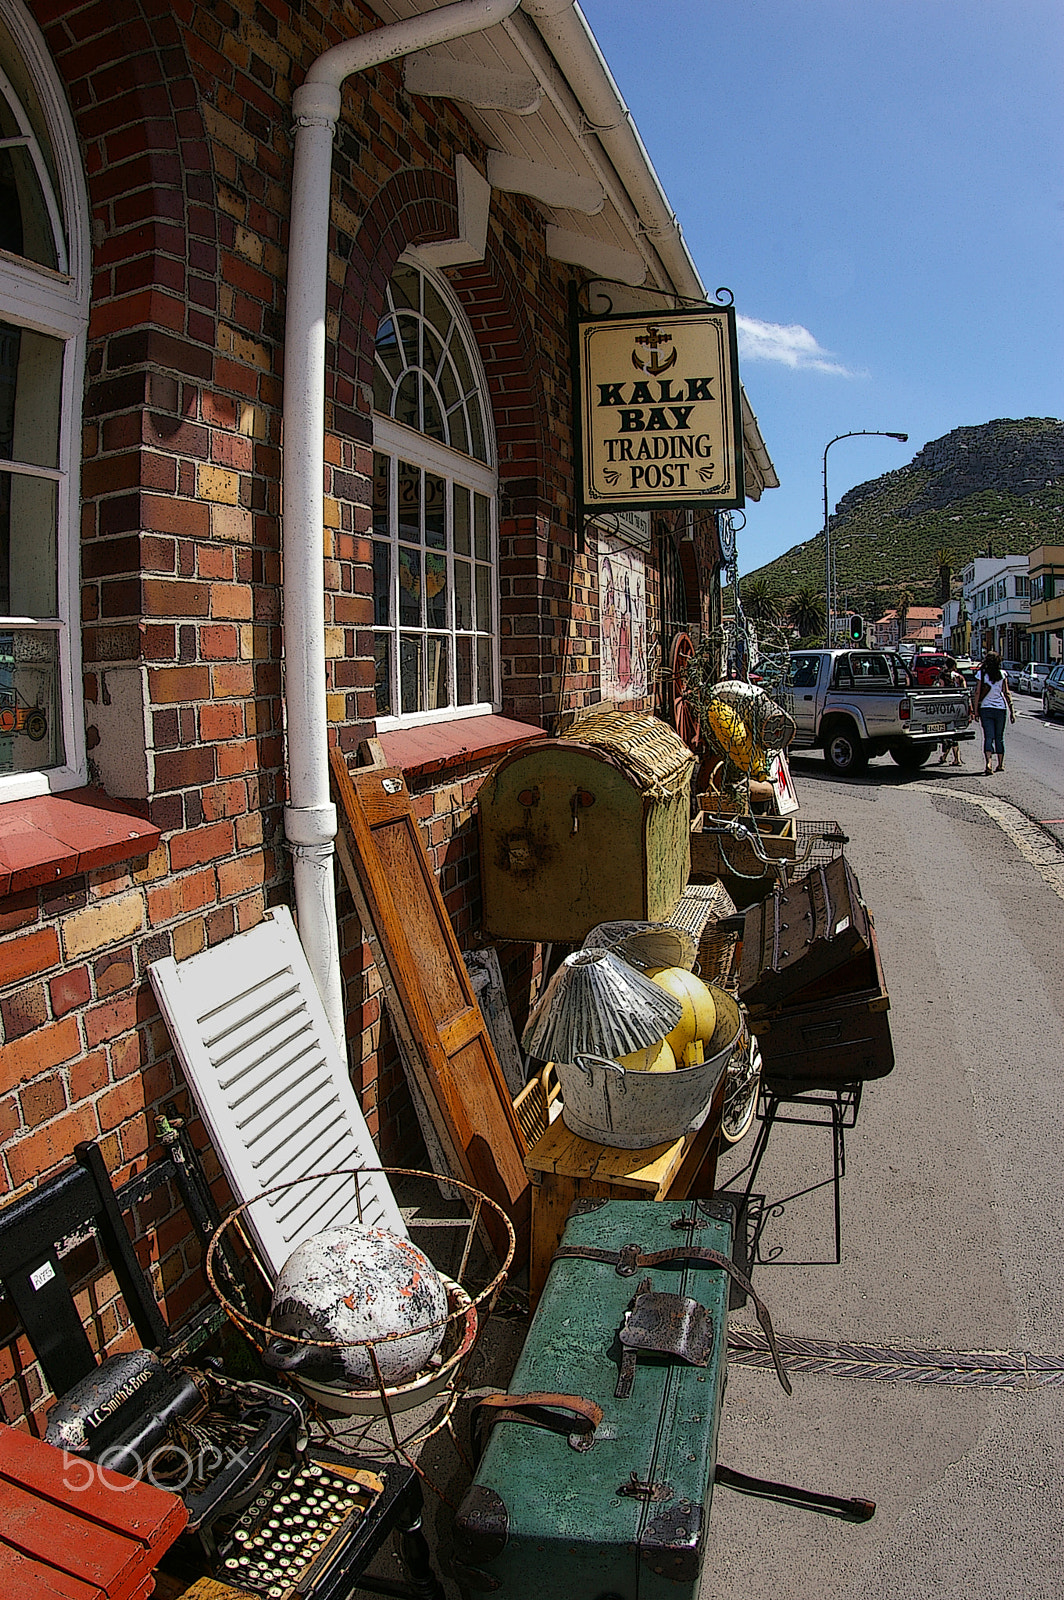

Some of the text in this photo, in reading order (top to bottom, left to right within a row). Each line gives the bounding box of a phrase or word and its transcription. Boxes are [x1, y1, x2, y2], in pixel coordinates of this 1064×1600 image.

[596, 377, 715, 407] KALK
[617, 405, 696, 433] BAY
[603, 434, 712, 462] TRADING
[630, 463, 690, 489] POST
[925, 703, 956, 715] TOYOTA
